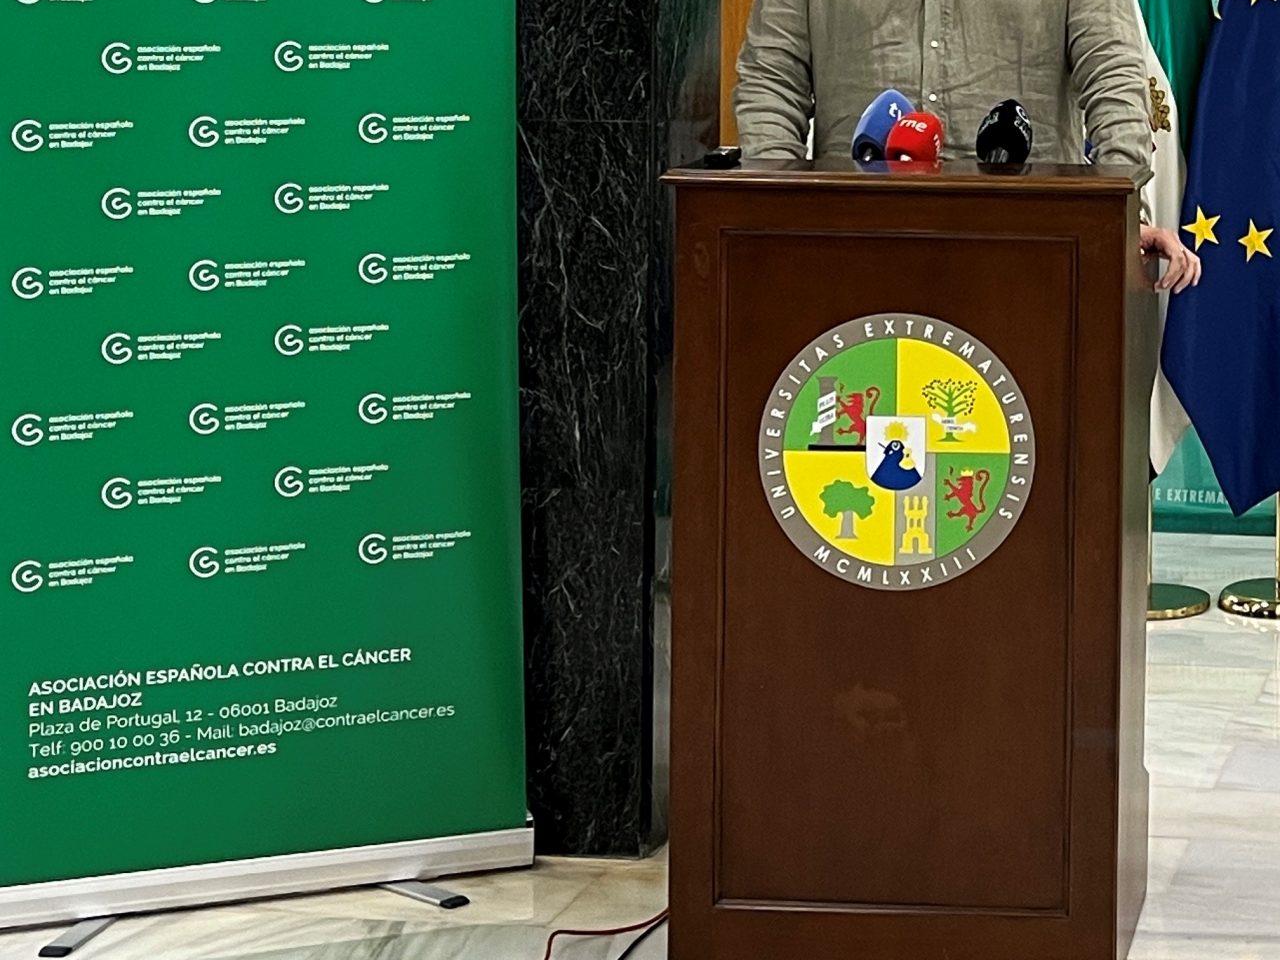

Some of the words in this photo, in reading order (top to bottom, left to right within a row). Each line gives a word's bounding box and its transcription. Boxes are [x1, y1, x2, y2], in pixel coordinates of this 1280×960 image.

[765, 334, 844, 519] UNIVERSITAS
[864, 320, 1029, 520] EXTREMATURENSIS
[814, 546, 977, 586] MCMLXXIII
[28, 670, 141, 697] ASOCIACIÓN
[146, 663, 239, 685] ESPAÑOLA
[242, 656, 314, 676] CONTRA
[318, 655, 339, 669] EL
[342, 648, 411, 666] CÁNCER
[29, 701, 54, 717] EN
[59, 692, 143, 714] BADAJOZ
[29, 721, 74, 737] Plaza
[79, 717, 101, 732] de
[185, 709, 202, 722] 12
[219, 703, 270, 719] 06001
[274, 695, 338, 713] Badajoz
[70, 739, 104, 756] 900
[109, 737, 128, 750] 10
[133, 734, 155, 747] 00
[160, 730, 180, 746] 36
[239, 704, 455, 737] badajoz@contraelcancer.es
[28, 742, 277, 779] asociacioncontraelcancer.es
